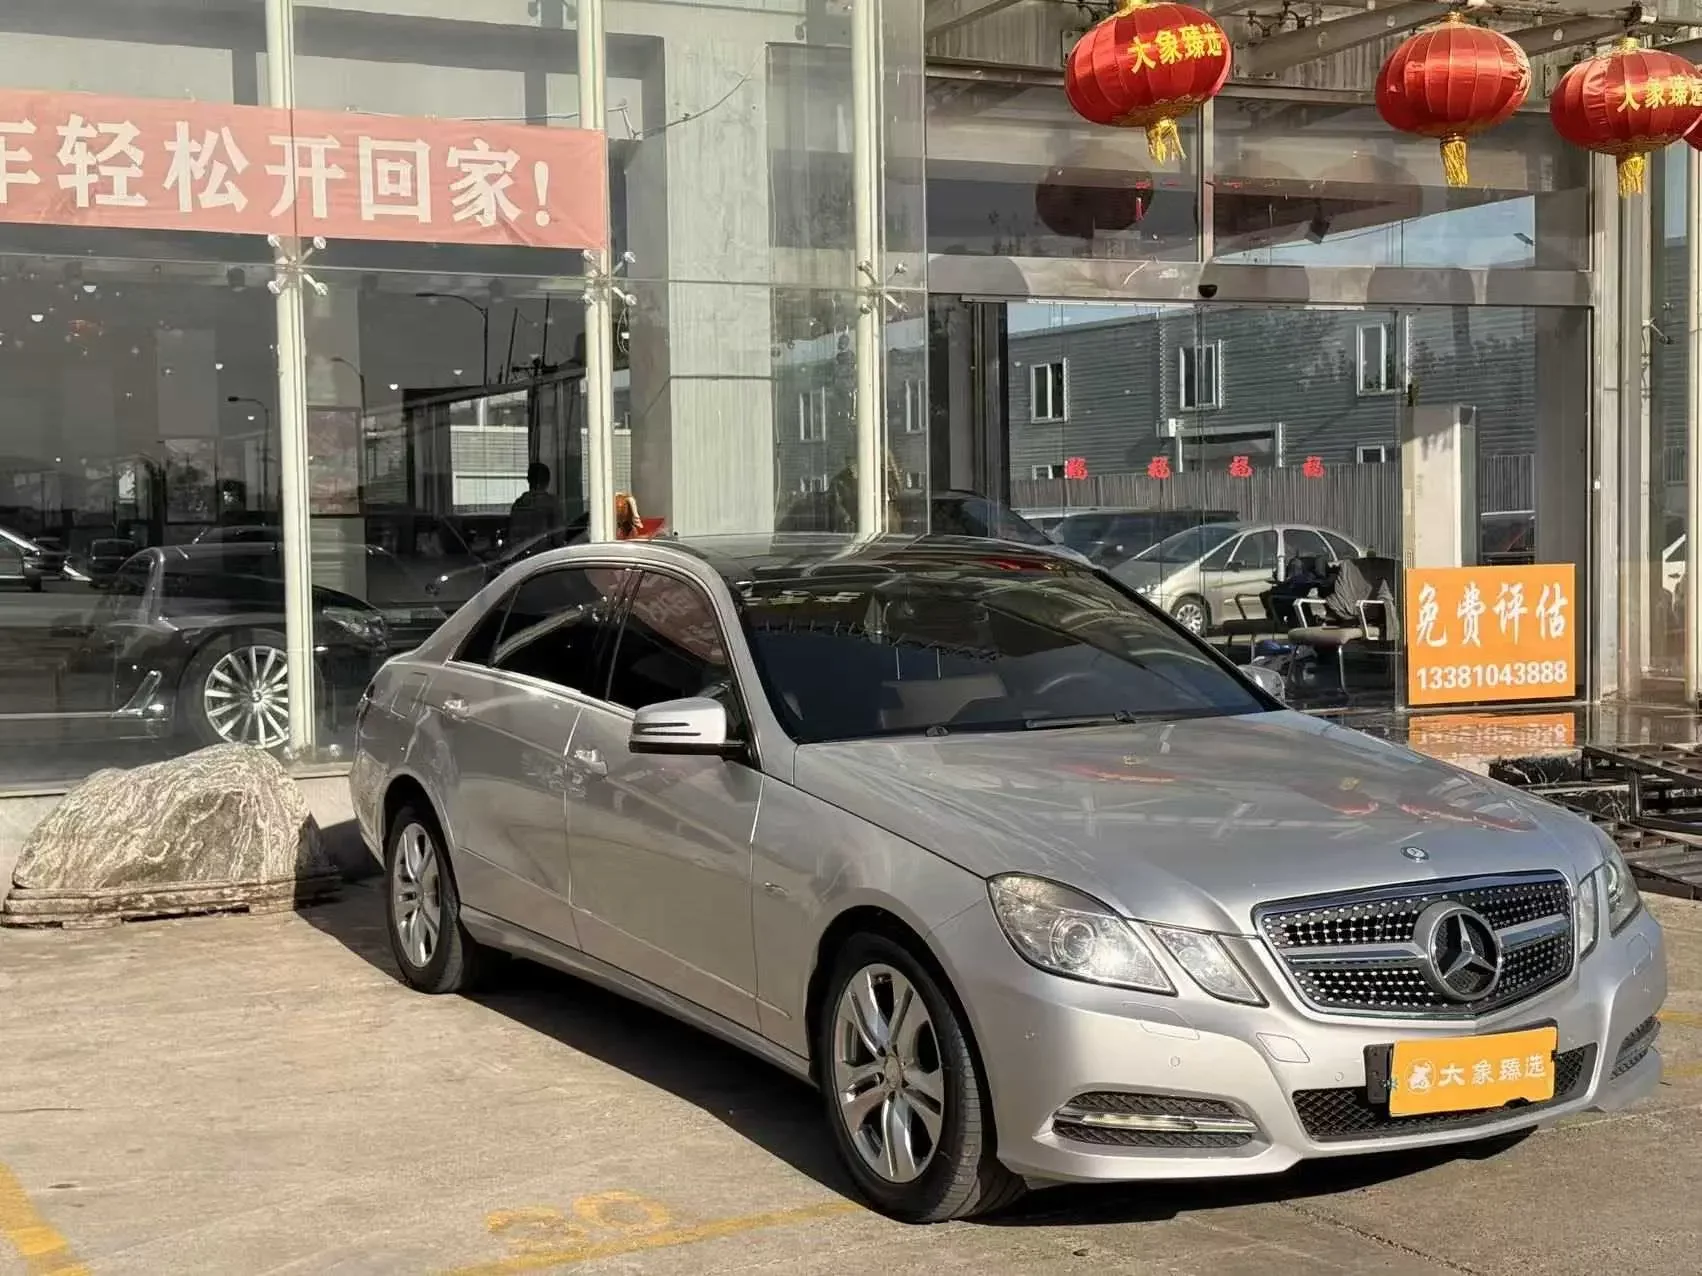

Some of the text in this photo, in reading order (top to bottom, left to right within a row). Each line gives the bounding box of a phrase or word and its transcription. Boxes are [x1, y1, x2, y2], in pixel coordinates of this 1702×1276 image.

[1127, 22, 1223, 74] 大象臻选
[1416, 581, 1569, 649] 免费评估
[1417, 660, 1568, 691] 13381043888
[1437, 1054, 1547, 1088] 大象臻选
